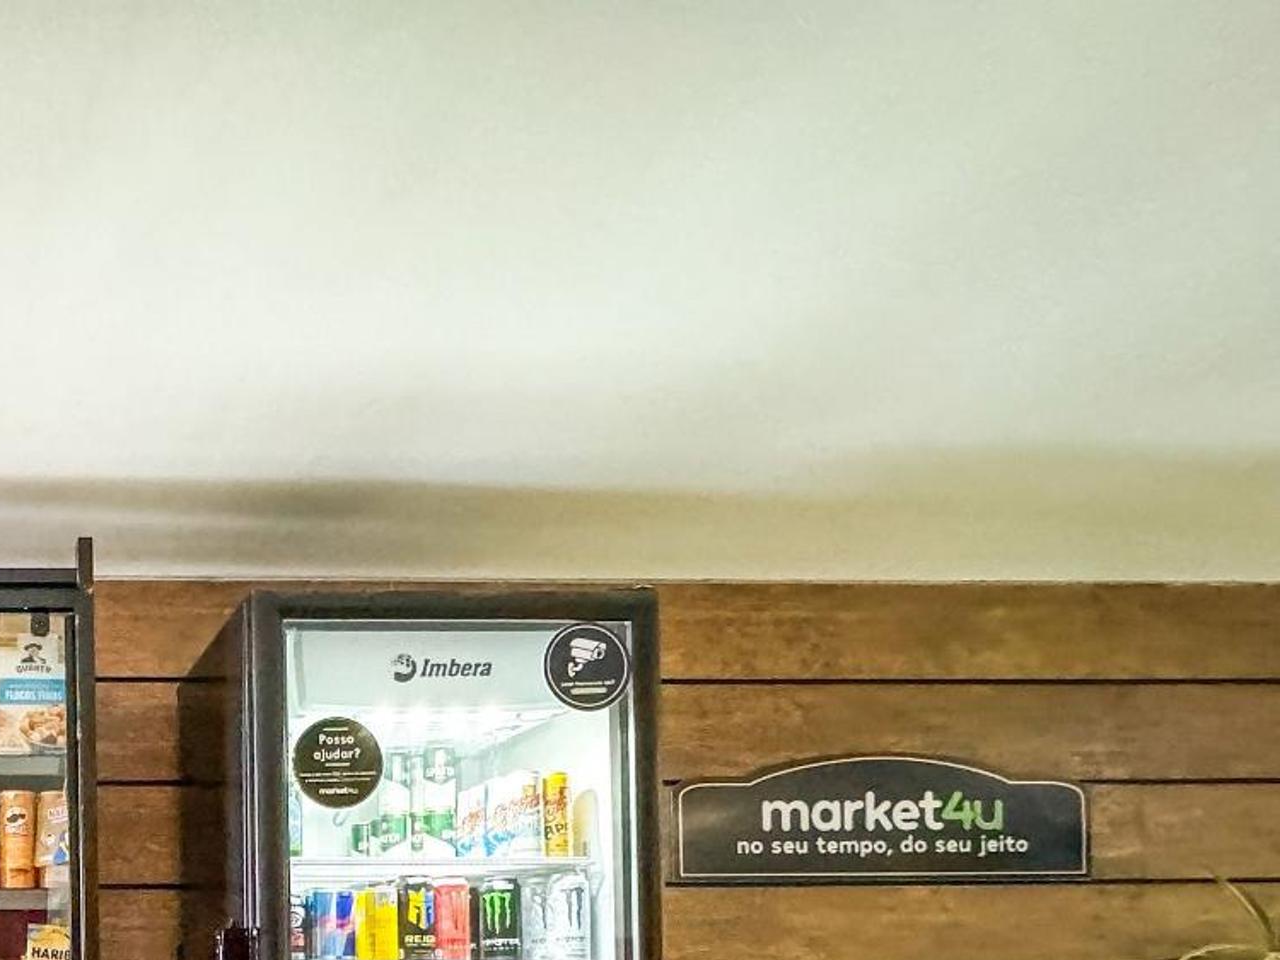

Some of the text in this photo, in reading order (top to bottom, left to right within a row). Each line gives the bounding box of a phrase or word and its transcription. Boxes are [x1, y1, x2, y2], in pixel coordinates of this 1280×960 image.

[420, 658, 493, 677] Imbera
[318, 733, 354, 745] Posso
[313, 748, 361, 762] ajudar?
[761, 791, 1004, 831] market4u
[736, 835, 1028, 857] no seu tempo, do seu jeito
